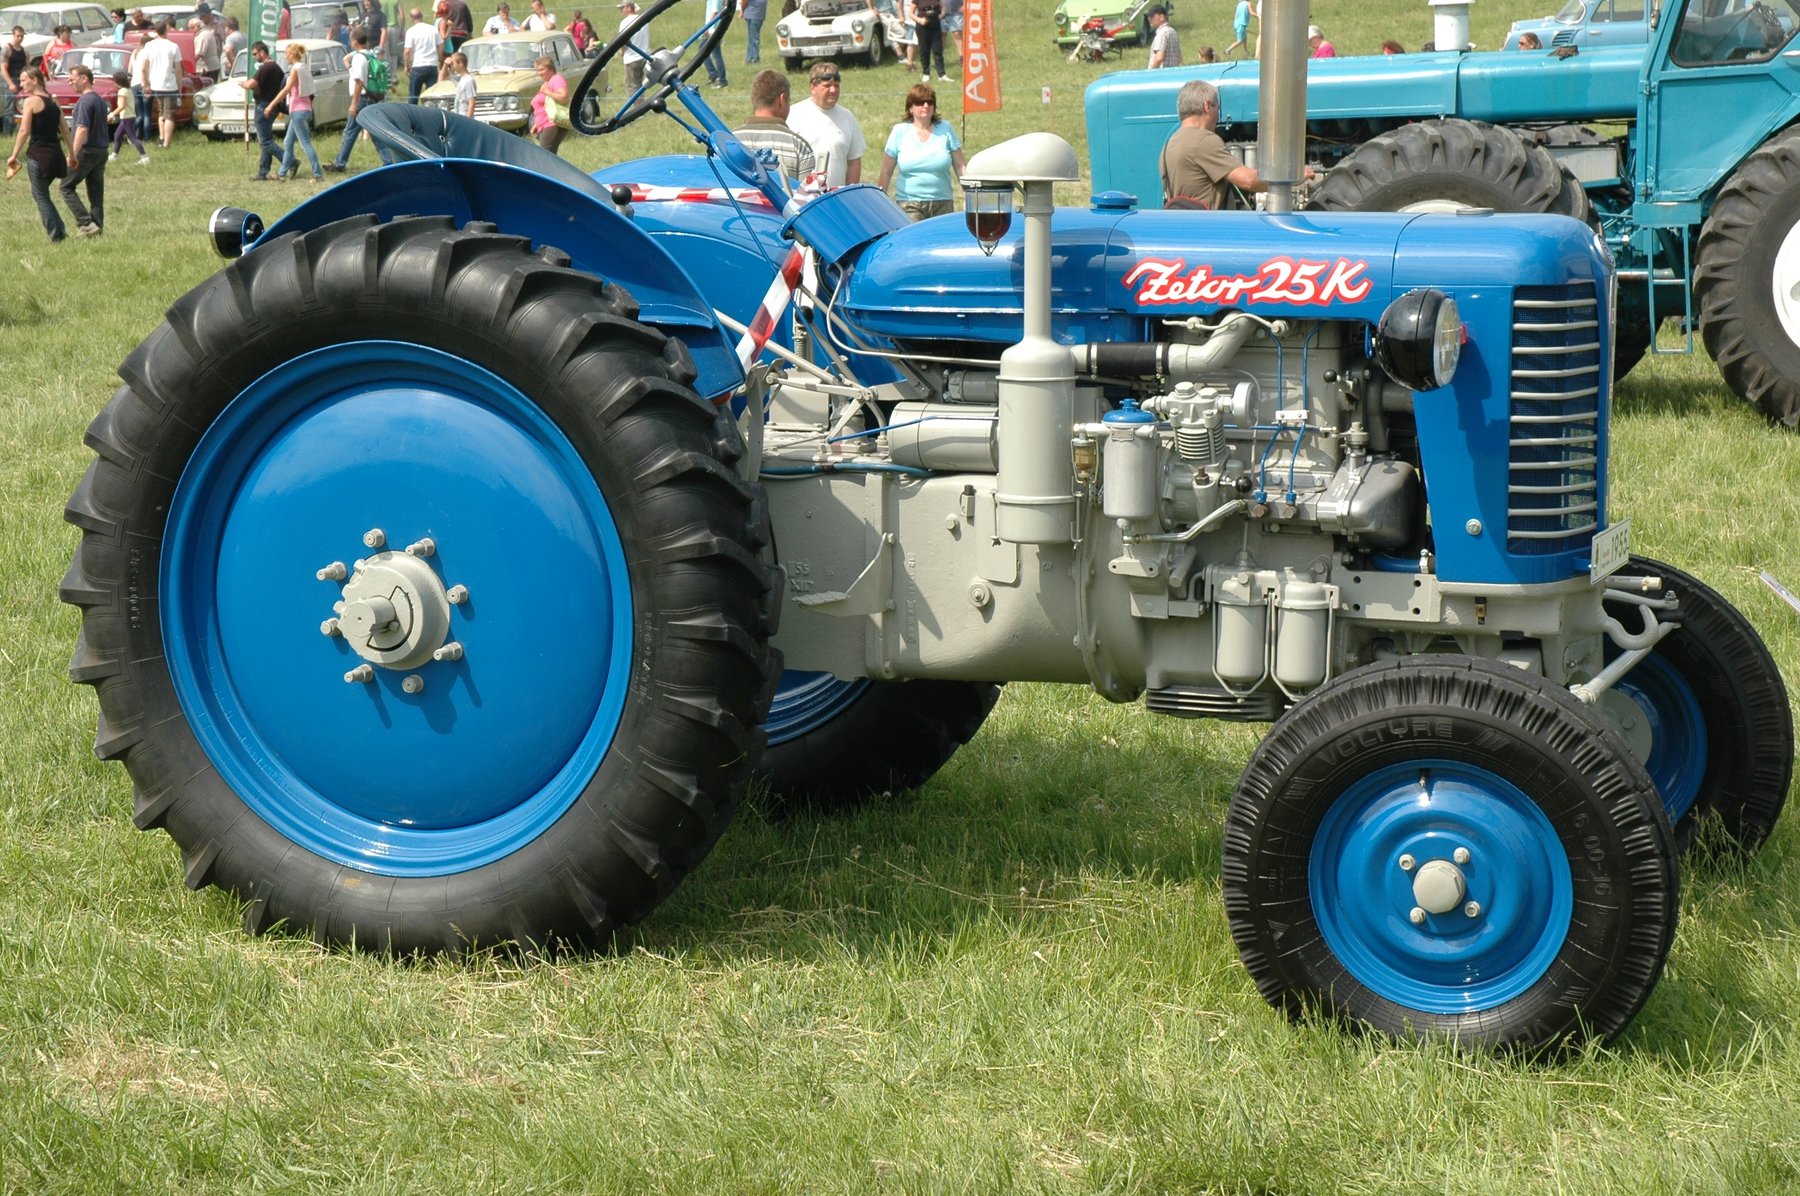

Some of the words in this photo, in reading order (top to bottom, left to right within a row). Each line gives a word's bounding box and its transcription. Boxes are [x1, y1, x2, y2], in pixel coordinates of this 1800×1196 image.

[1122, 257, 1260, 306] Zetor
[1252, 256, 1374, 306] 25K
[1319, 716, 1454, 766] VOLTYRE
